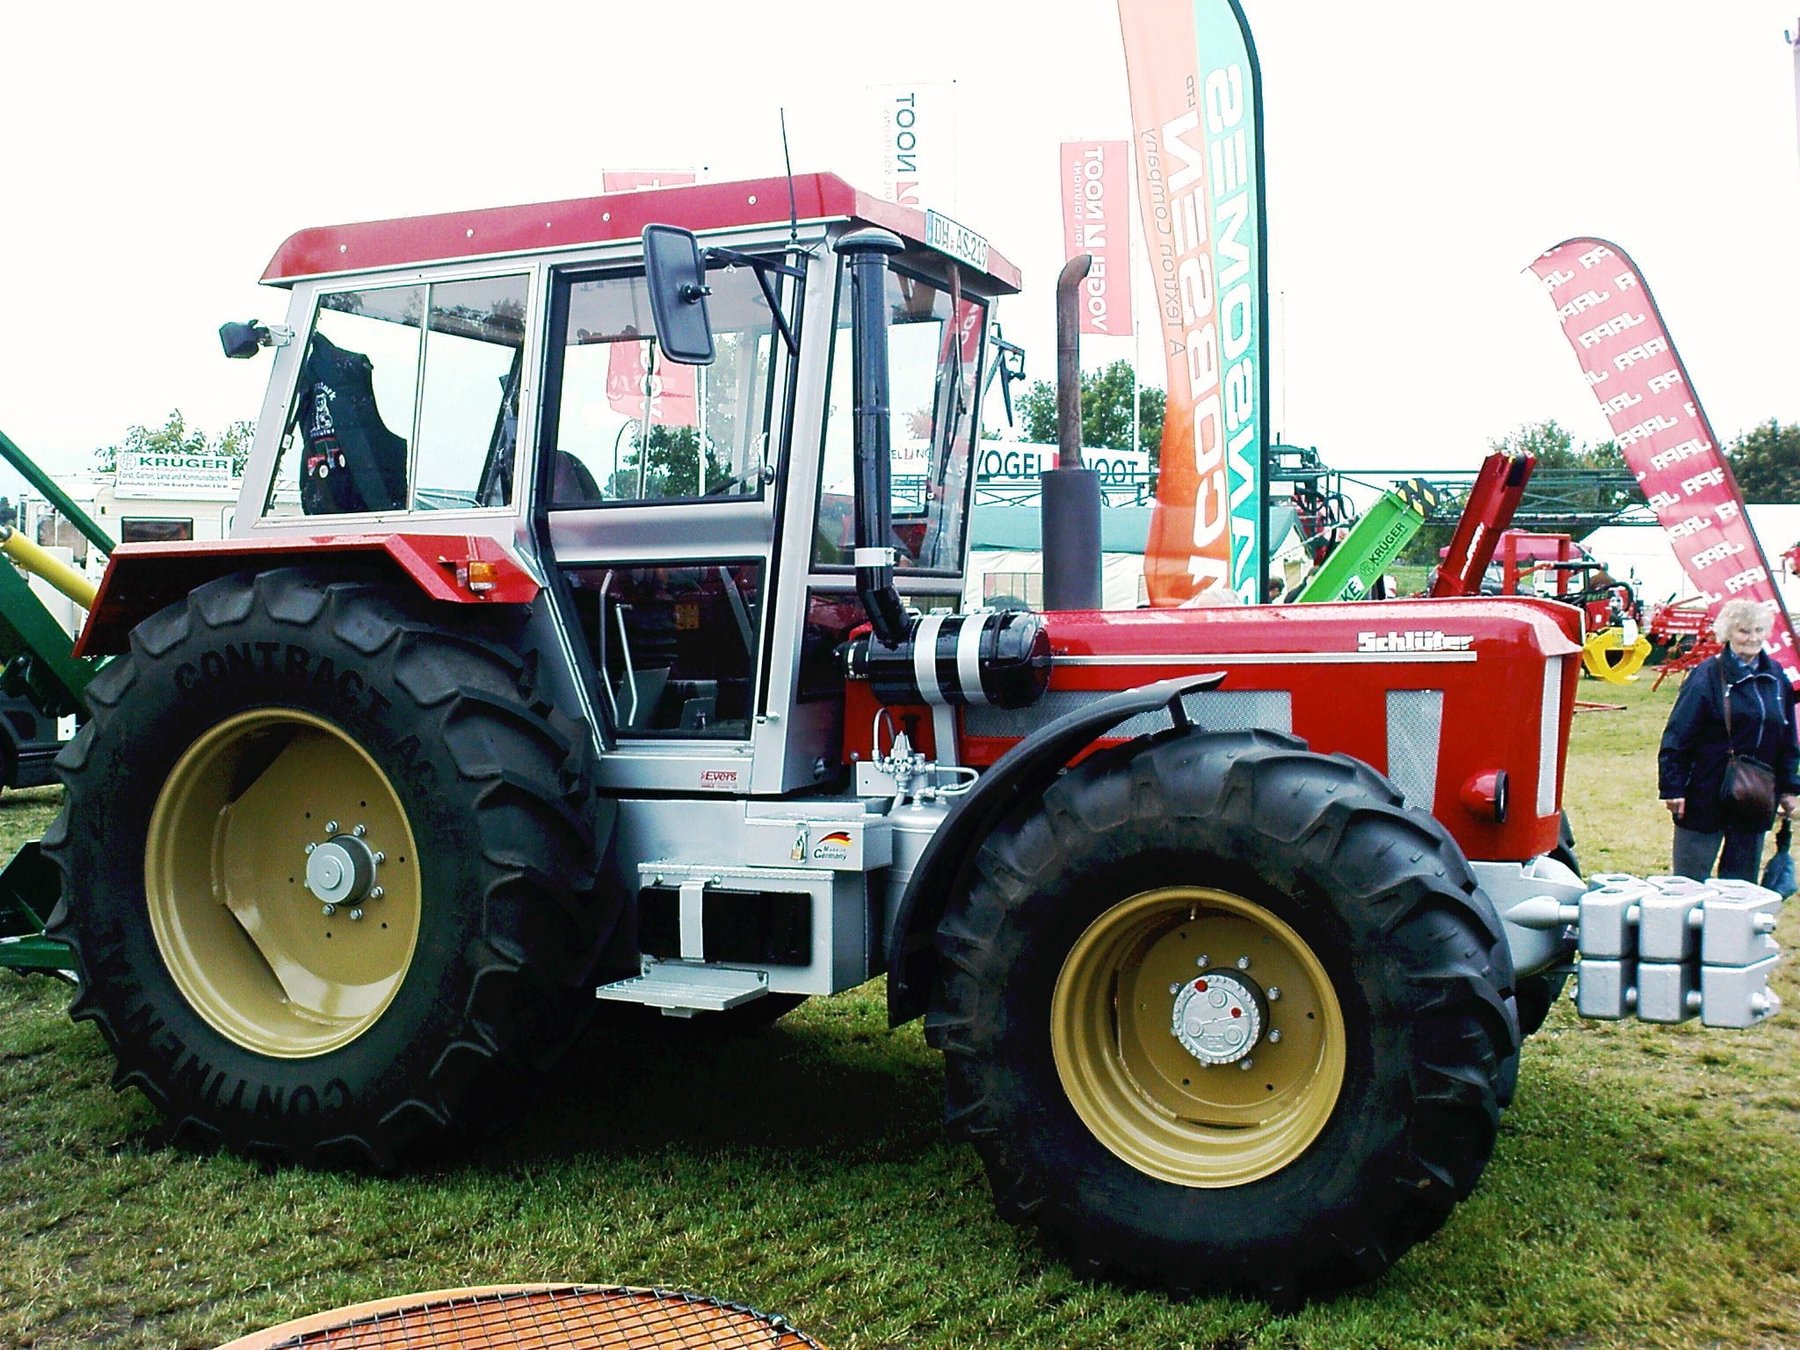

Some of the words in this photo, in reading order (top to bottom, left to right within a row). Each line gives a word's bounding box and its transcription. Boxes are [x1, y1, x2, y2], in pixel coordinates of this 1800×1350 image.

[139, 455, 228, 469] KRÜGER
[1357, 631, 1475, 652] Schlüter
[174, 641, 393, 723] CONTRACT
[705, 771, 737, 781] Evers
[814, 848, 847, 861] Germany
